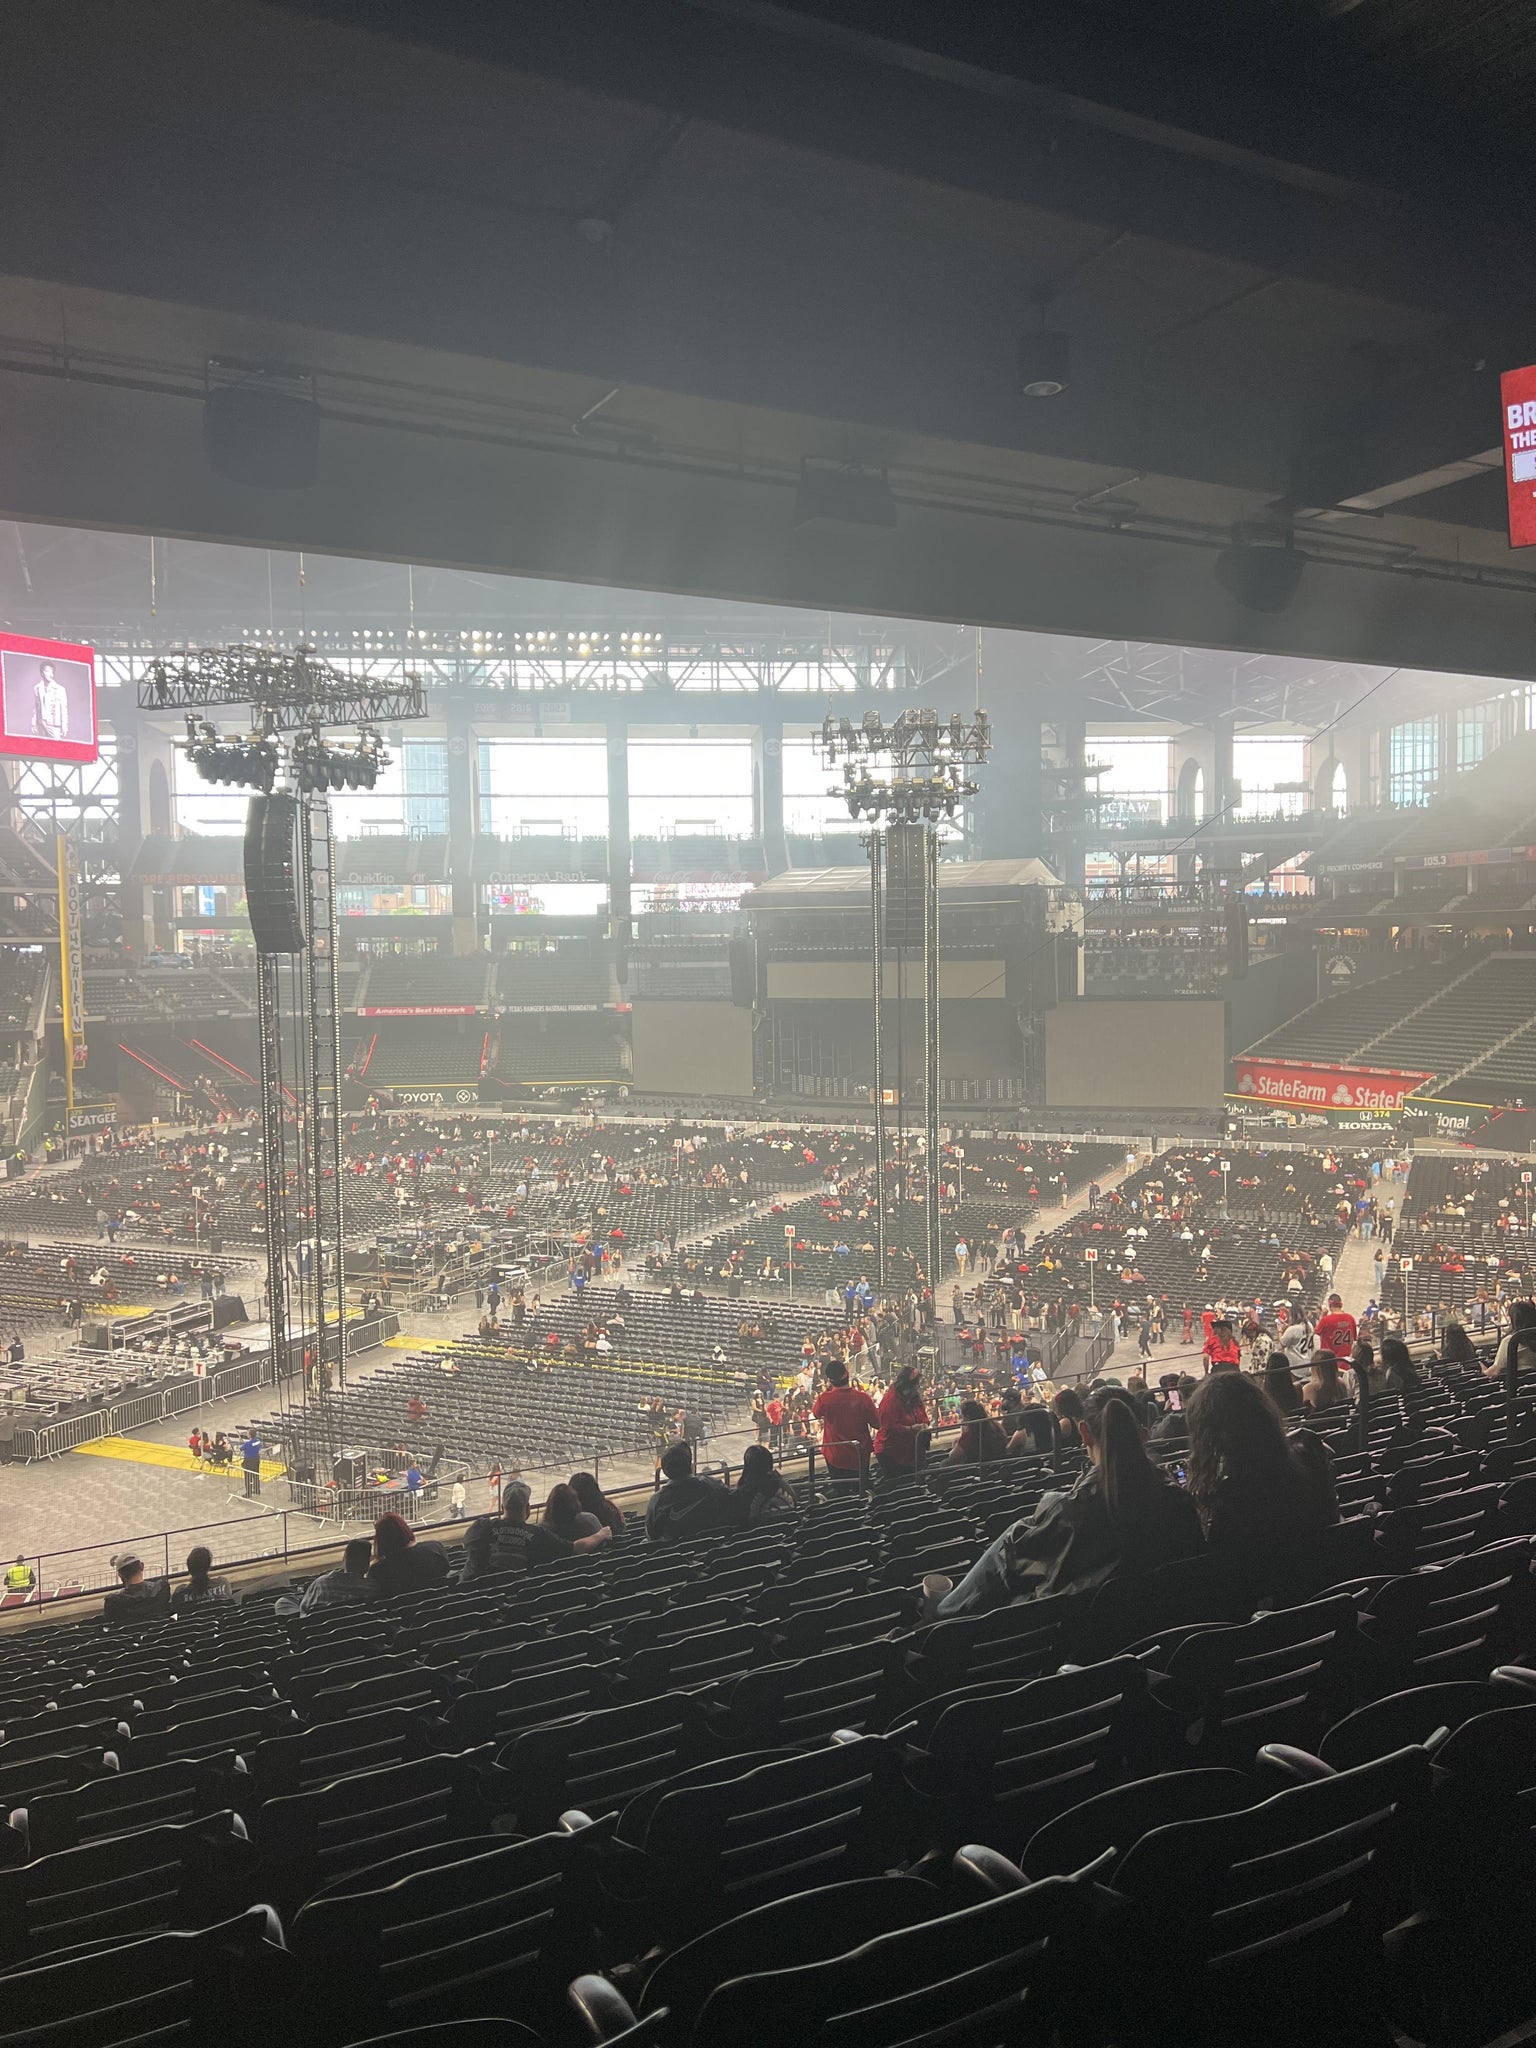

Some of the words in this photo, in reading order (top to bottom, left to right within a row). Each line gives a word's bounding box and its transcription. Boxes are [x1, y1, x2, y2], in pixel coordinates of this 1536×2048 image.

[398, 1092, 444, 1102] TOYOTA
[1373, 1110, 1391, 1118] 374
[1338, 1121, 1394, 1131] HONDA
[1333, 1329, 1351, 1347] 24
[1300, 1335, 1314, 1354] 24
